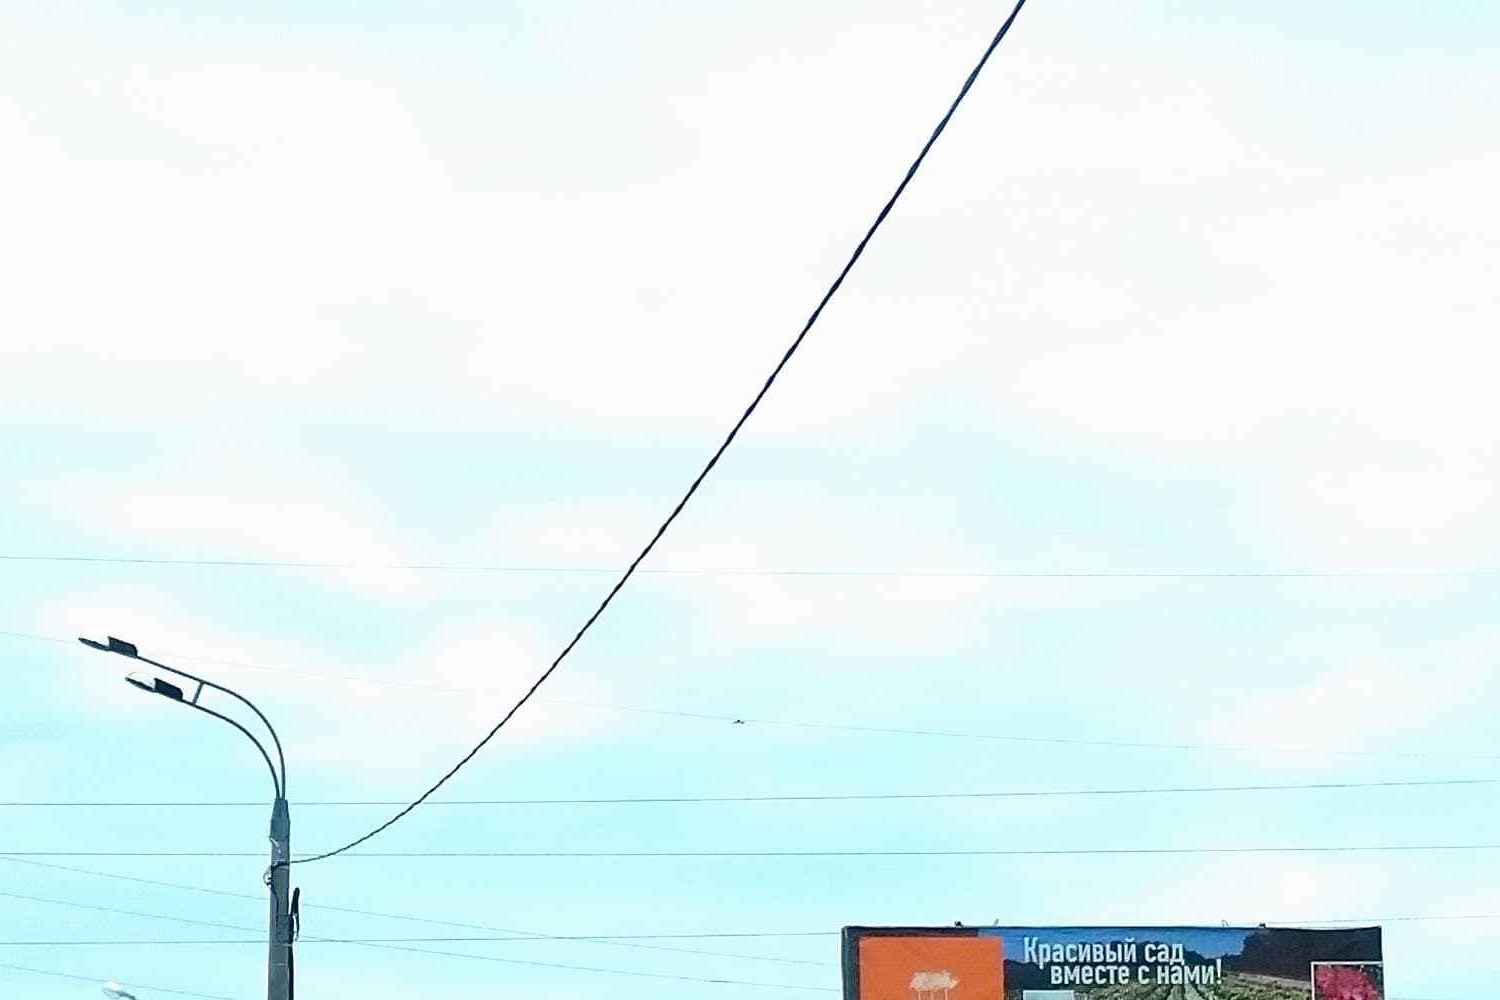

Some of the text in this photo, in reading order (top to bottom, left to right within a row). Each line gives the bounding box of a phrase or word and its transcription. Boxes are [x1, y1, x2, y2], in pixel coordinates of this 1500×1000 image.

[1023, 936, 1185, 970] Красивый сад
[1050, 958, 1222, 985] вместе с нами!
